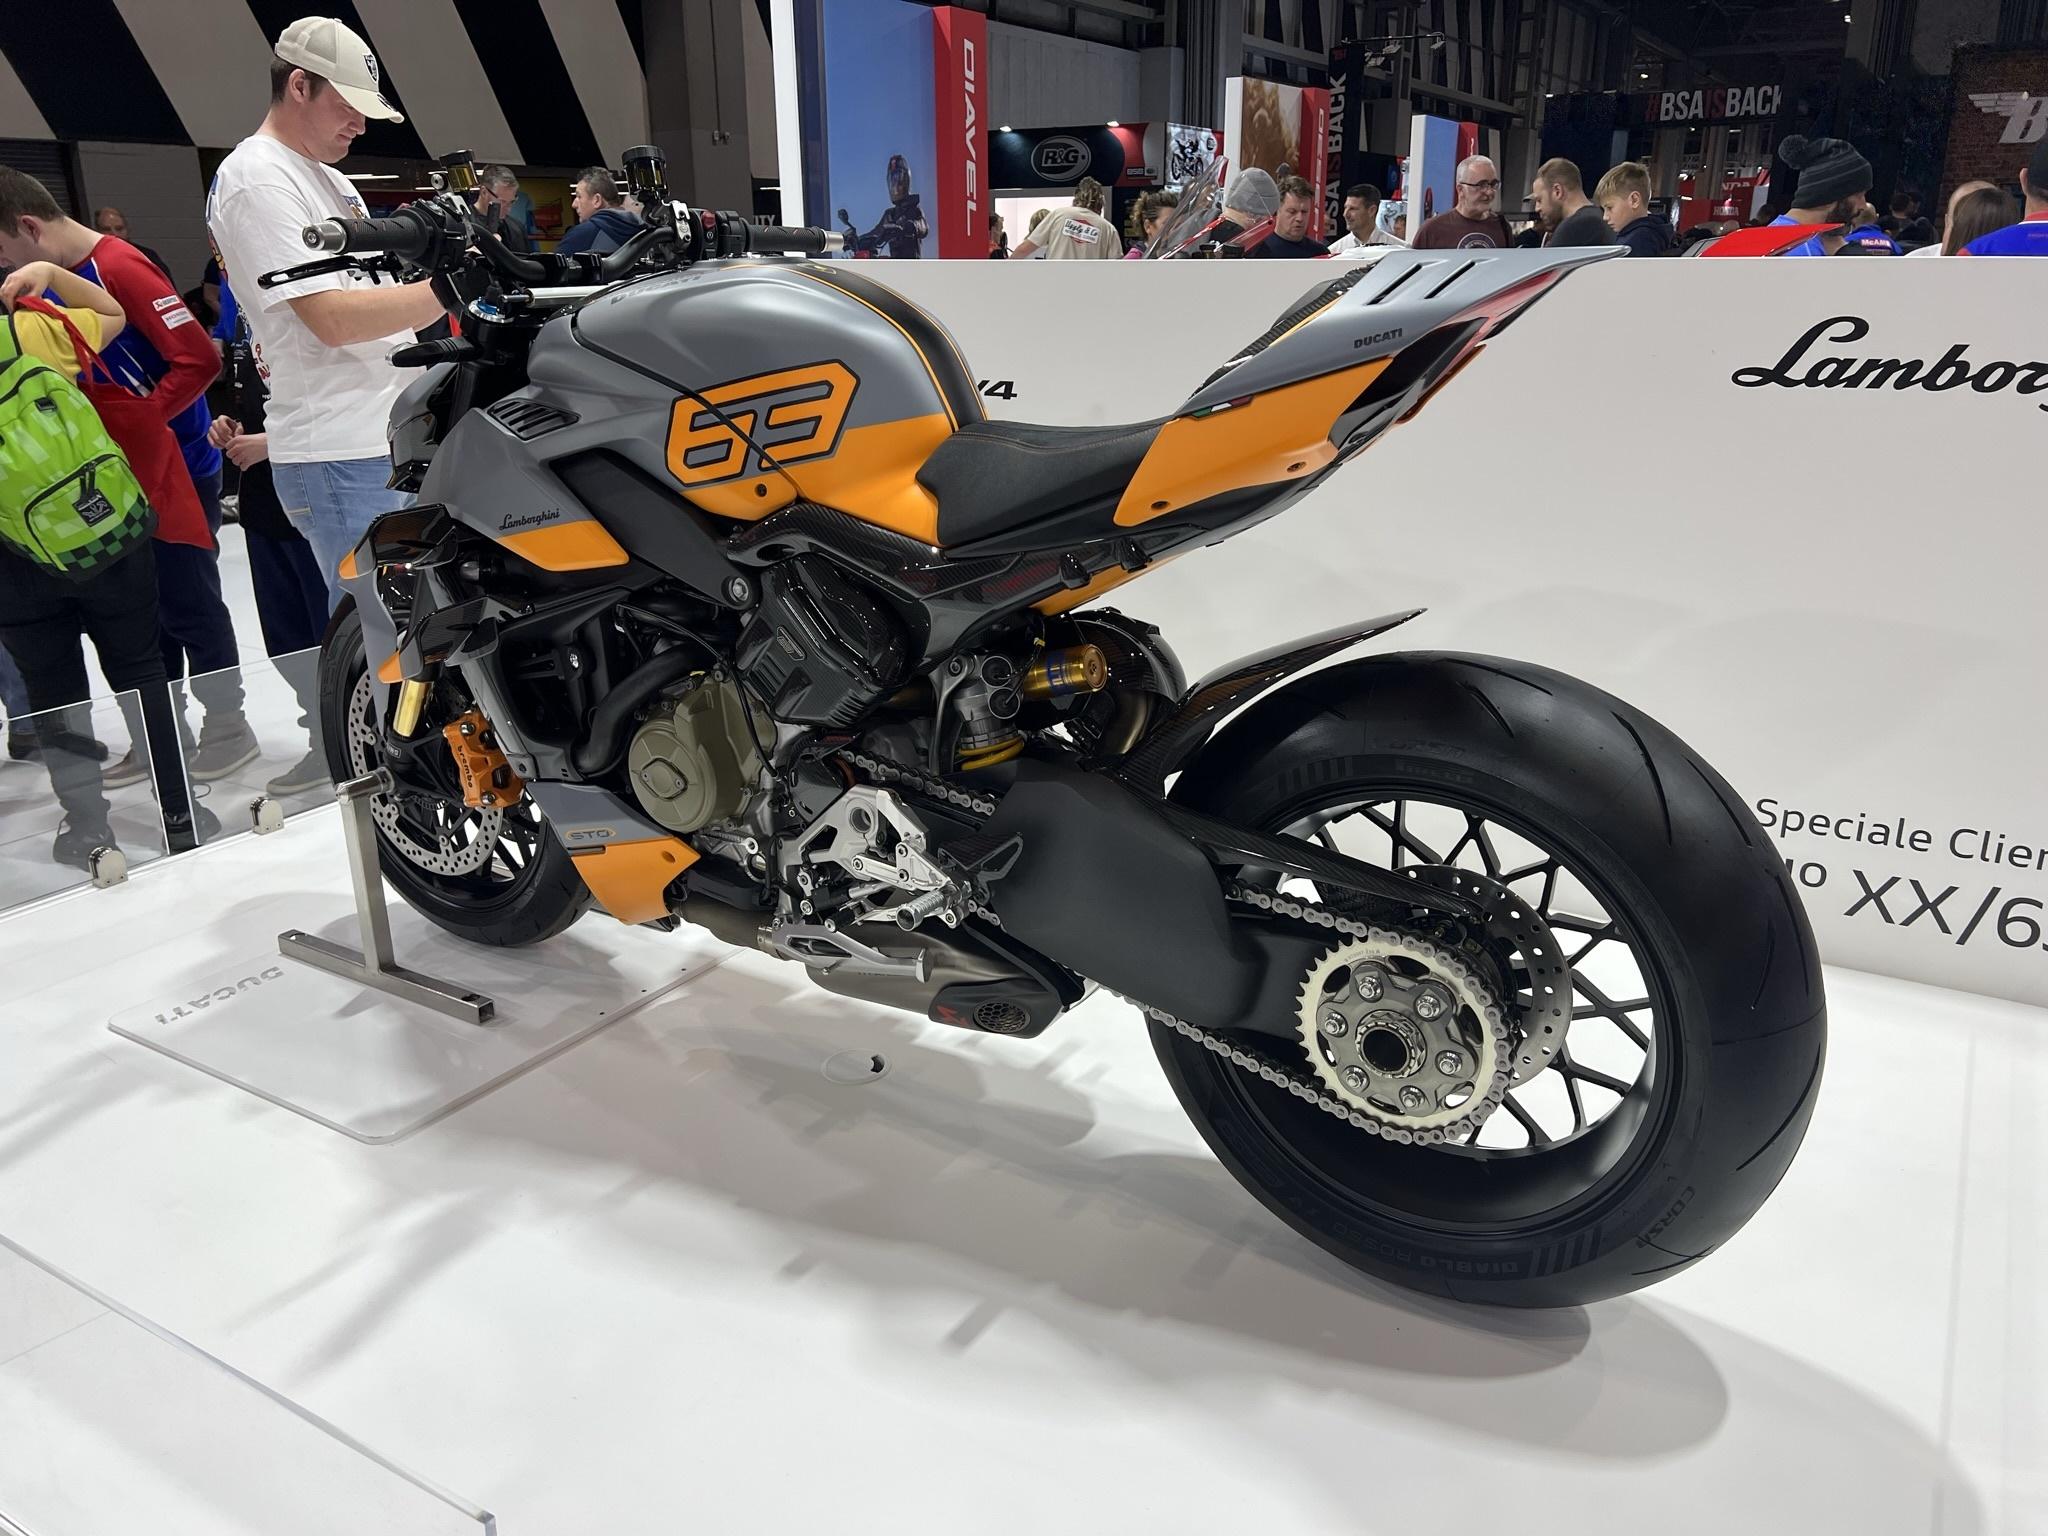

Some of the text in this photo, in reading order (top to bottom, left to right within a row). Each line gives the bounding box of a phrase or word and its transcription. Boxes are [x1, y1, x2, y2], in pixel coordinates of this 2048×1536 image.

[963, 38, 977, 236] DIAVEL
[1042, 148, 1080, 167] R&G
[1353, 328, 1403, 349] DUCATI
[1731, 316, 2048, 412] Lambor
[664, 358, 861, 488] 63
[499, 508, 560, 531] Lamborghini
[457, 745, 473, 788] brembo
[1756, 798, 1932, 852] Speciale
[1843, 868, 2048, 953] XX/6
[154, 966, 285, 1025] DUCATI
[1419, 1255, 1519, 1276] DIABLO
